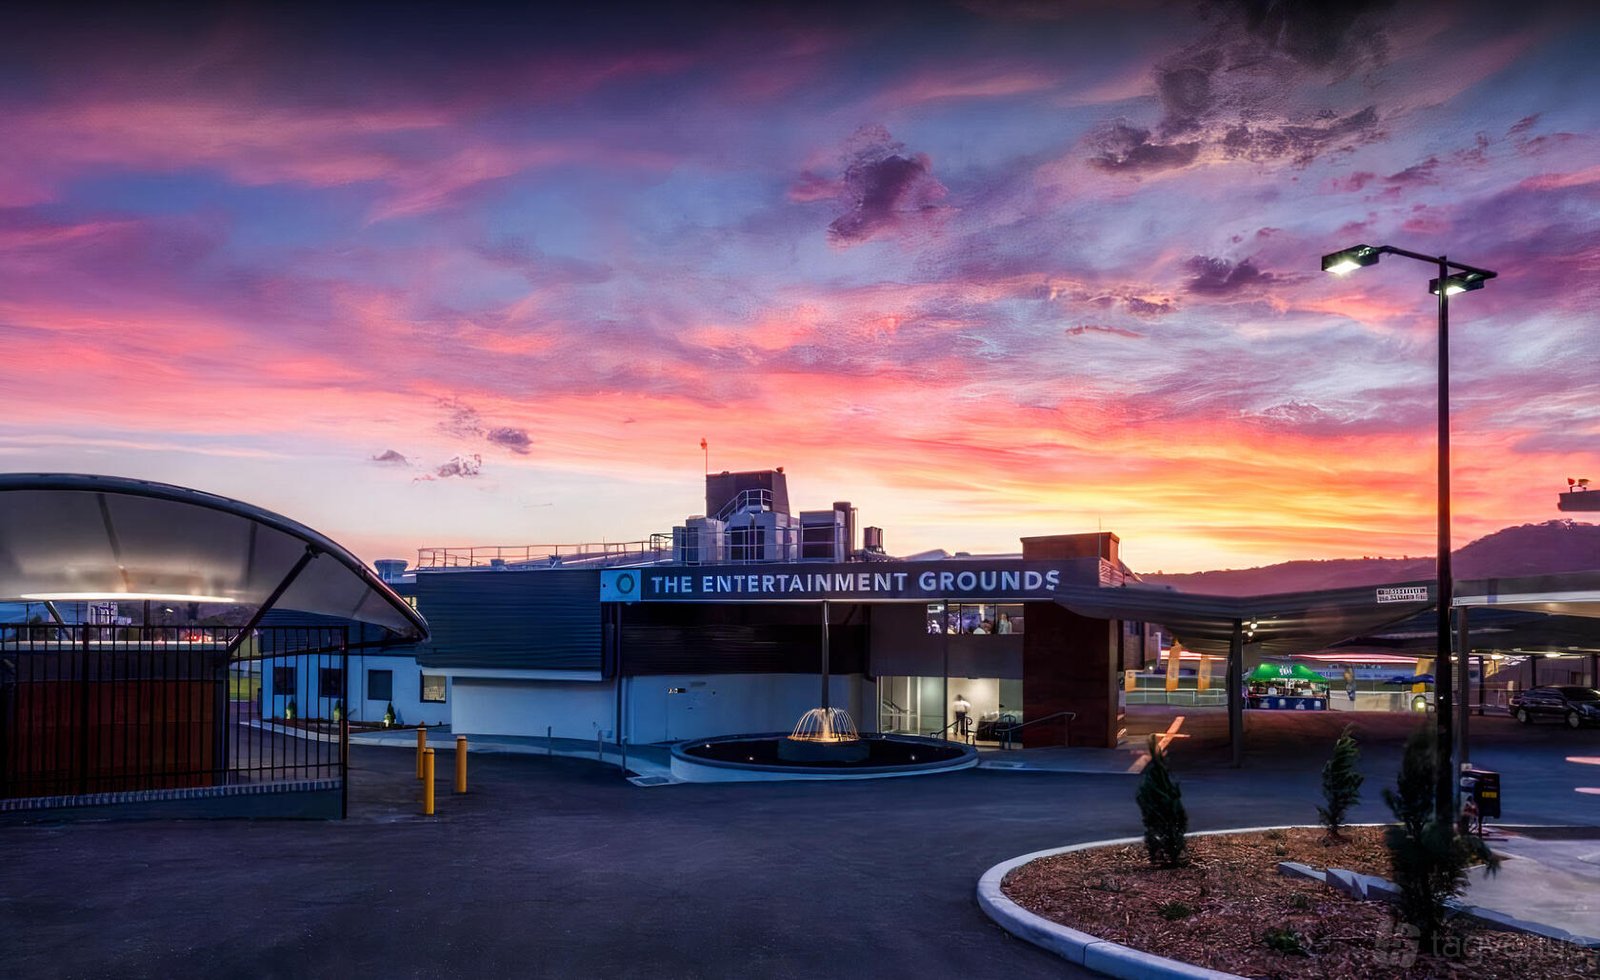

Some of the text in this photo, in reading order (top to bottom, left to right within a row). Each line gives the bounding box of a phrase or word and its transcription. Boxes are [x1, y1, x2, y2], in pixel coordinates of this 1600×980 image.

[651, 569, 1060, 593] THE ENTERTAINMENT GROUNDS
